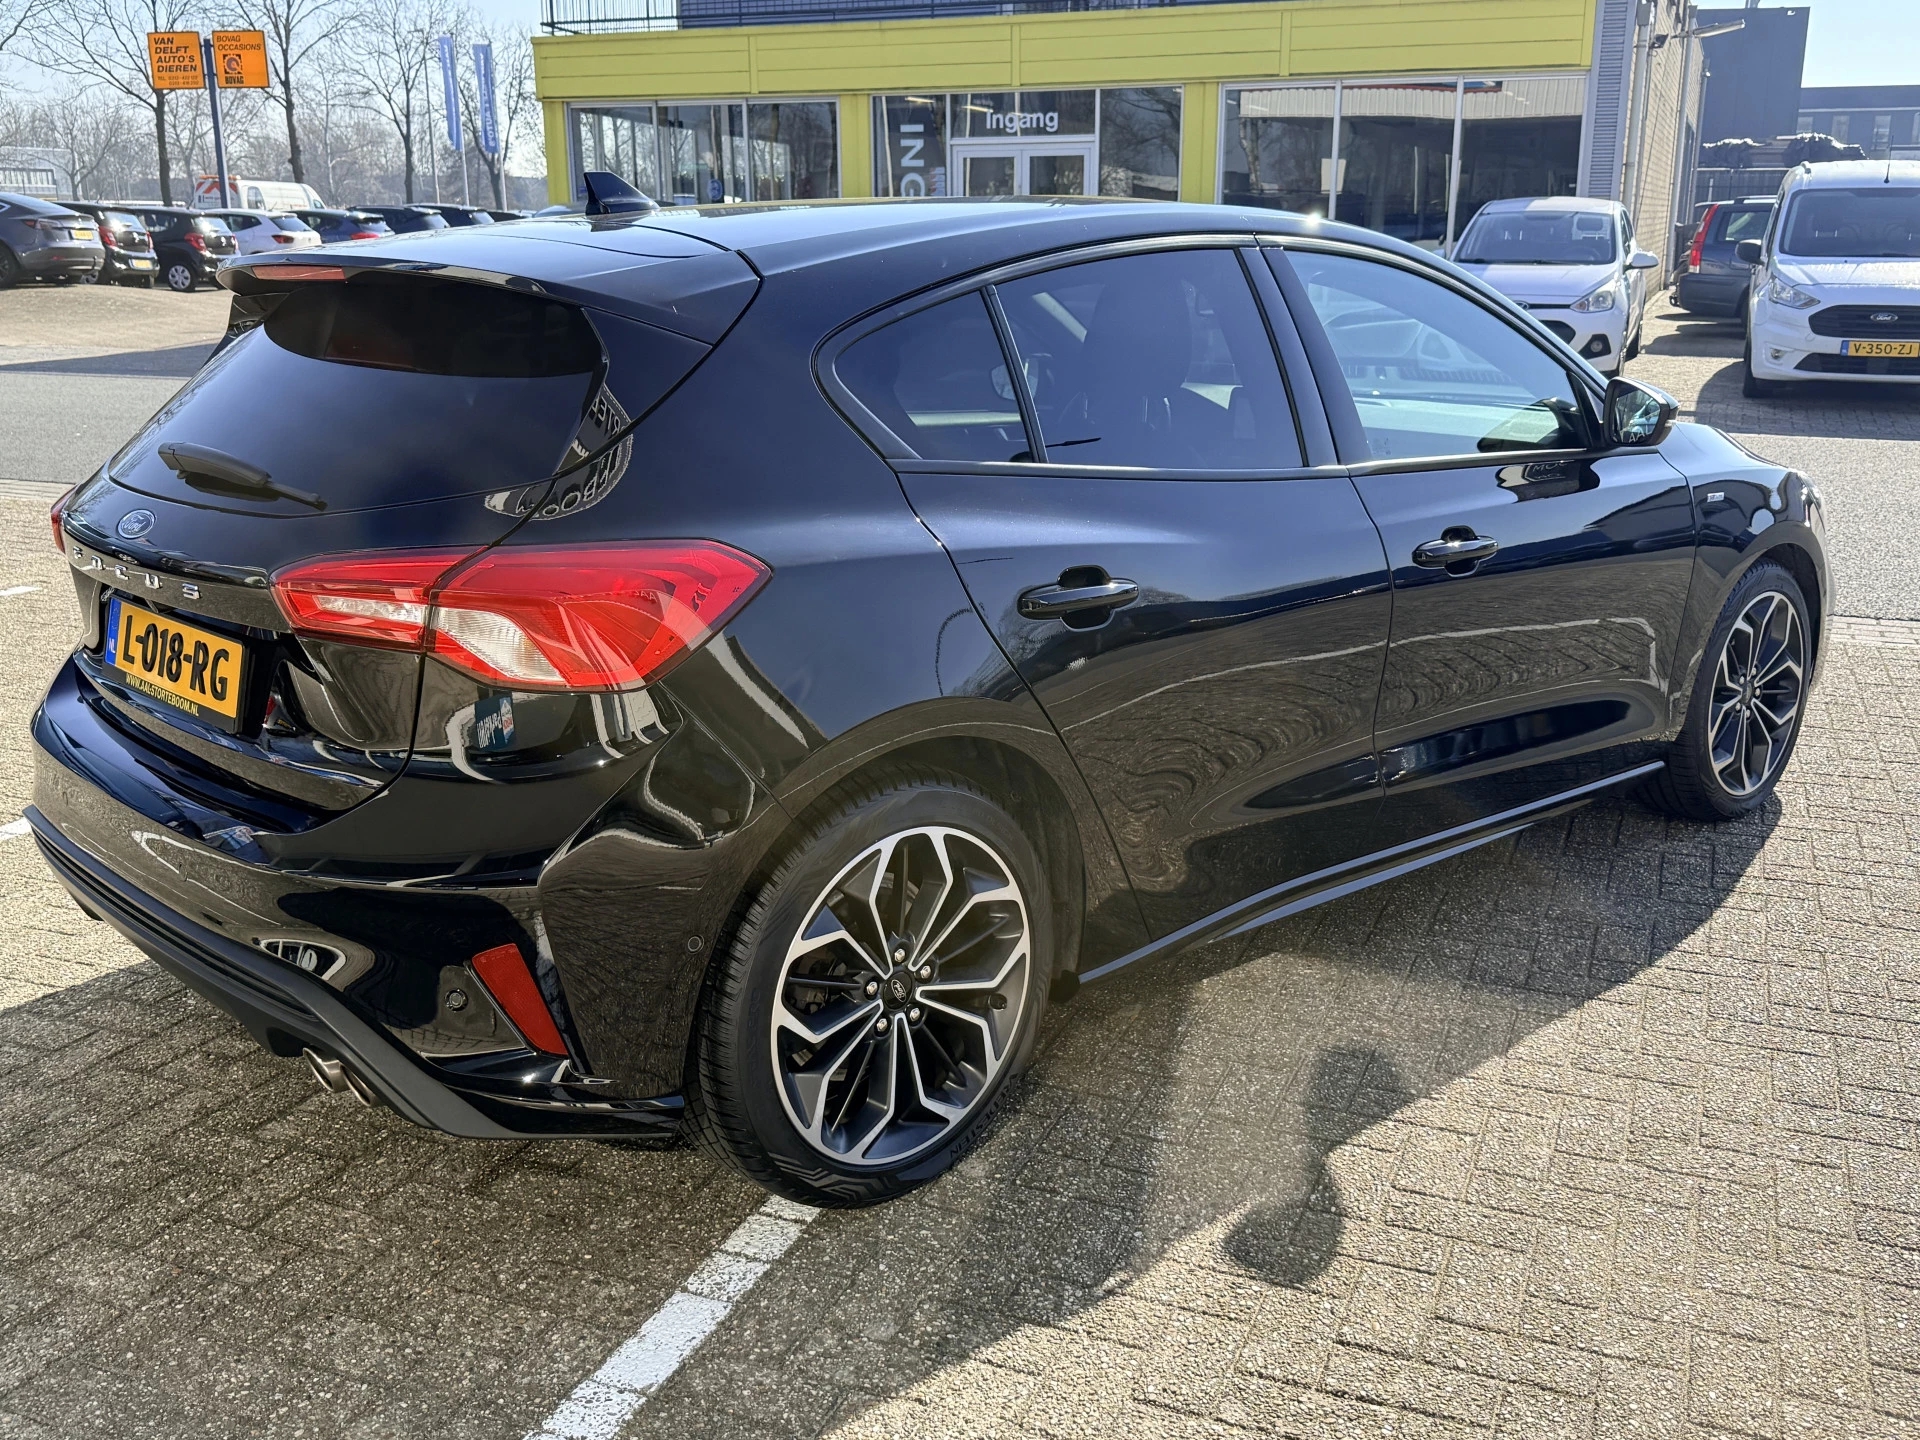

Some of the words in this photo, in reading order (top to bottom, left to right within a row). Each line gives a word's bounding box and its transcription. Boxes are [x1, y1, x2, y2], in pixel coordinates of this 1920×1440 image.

[153, 37, 174, 45] VAN
[216, 35, 241, 43] BOVAG
[154, 46, 189, 54] DELFT
[217, 43, 262, 51] OCCASIONS
[156, 55, 195, 64] AUTO'S
[157, 64, 197, 73] DIEREN
[225, 75, 244, 85] BOVAG
[985, 110, 1059, 133] Ingang
[1853, 343, 1913, 355] V-350-ZJ
[121, 515, 146, 534] Ford
[73, 545, 201, 600] FOCUS
[108, 637, 116, 654] NL
[122, 614, 230, 702] L-018-RG
[126, 673, 200, 718] WWW.AAL-STORTEBOOM.NL
